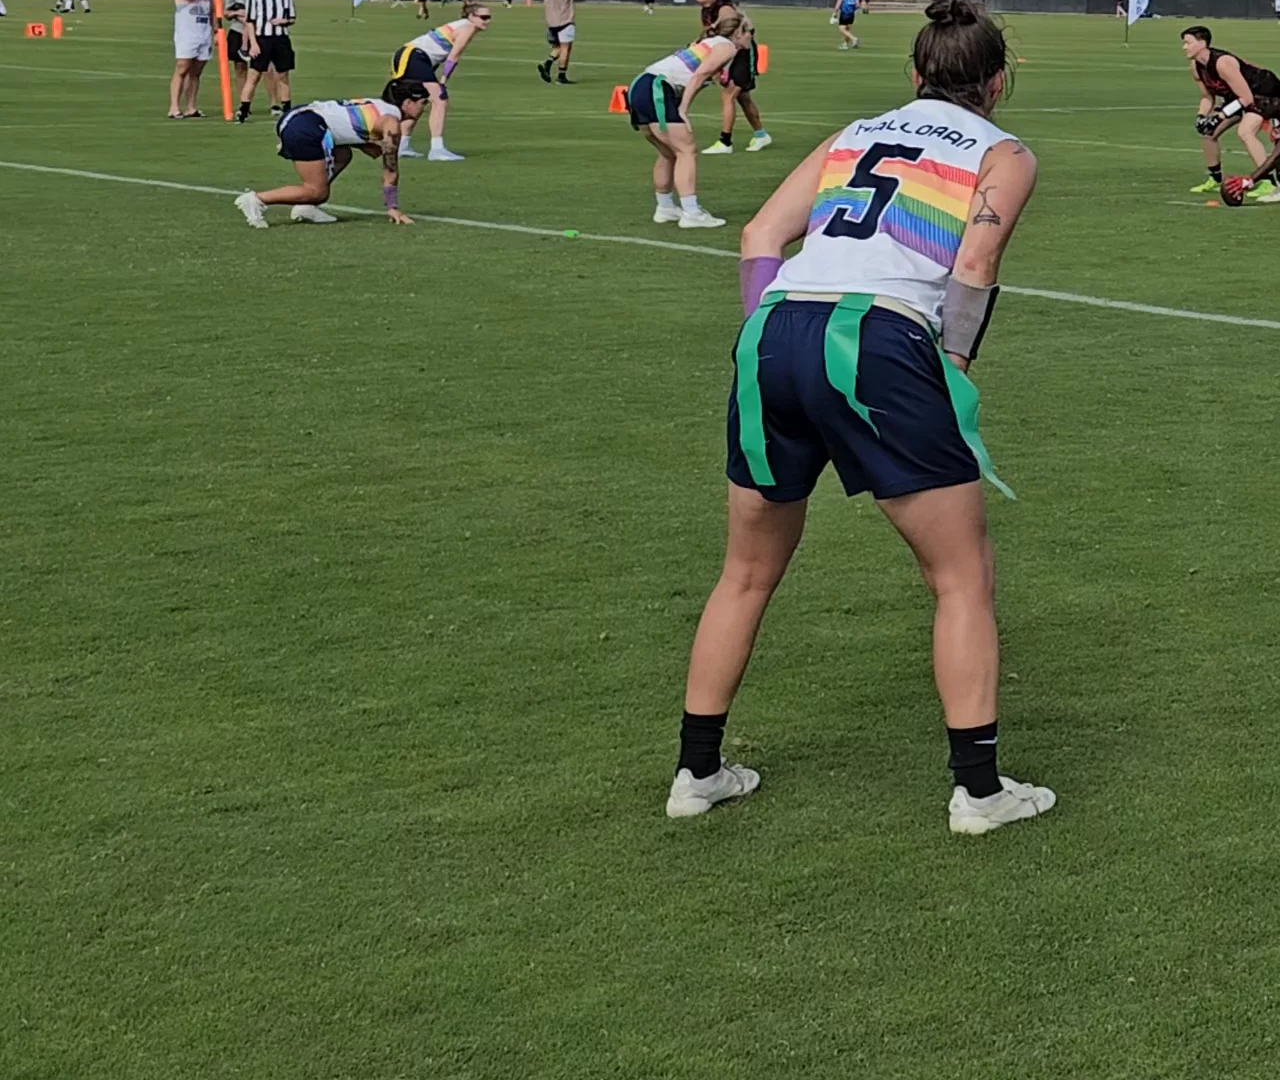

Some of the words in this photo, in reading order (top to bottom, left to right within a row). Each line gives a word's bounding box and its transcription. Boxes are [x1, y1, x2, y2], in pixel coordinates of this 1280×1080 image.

[31, 24, 43, 37] G
[855, 119, 979, 151] HALLORAN
[821, 141, 925, 240] 5
